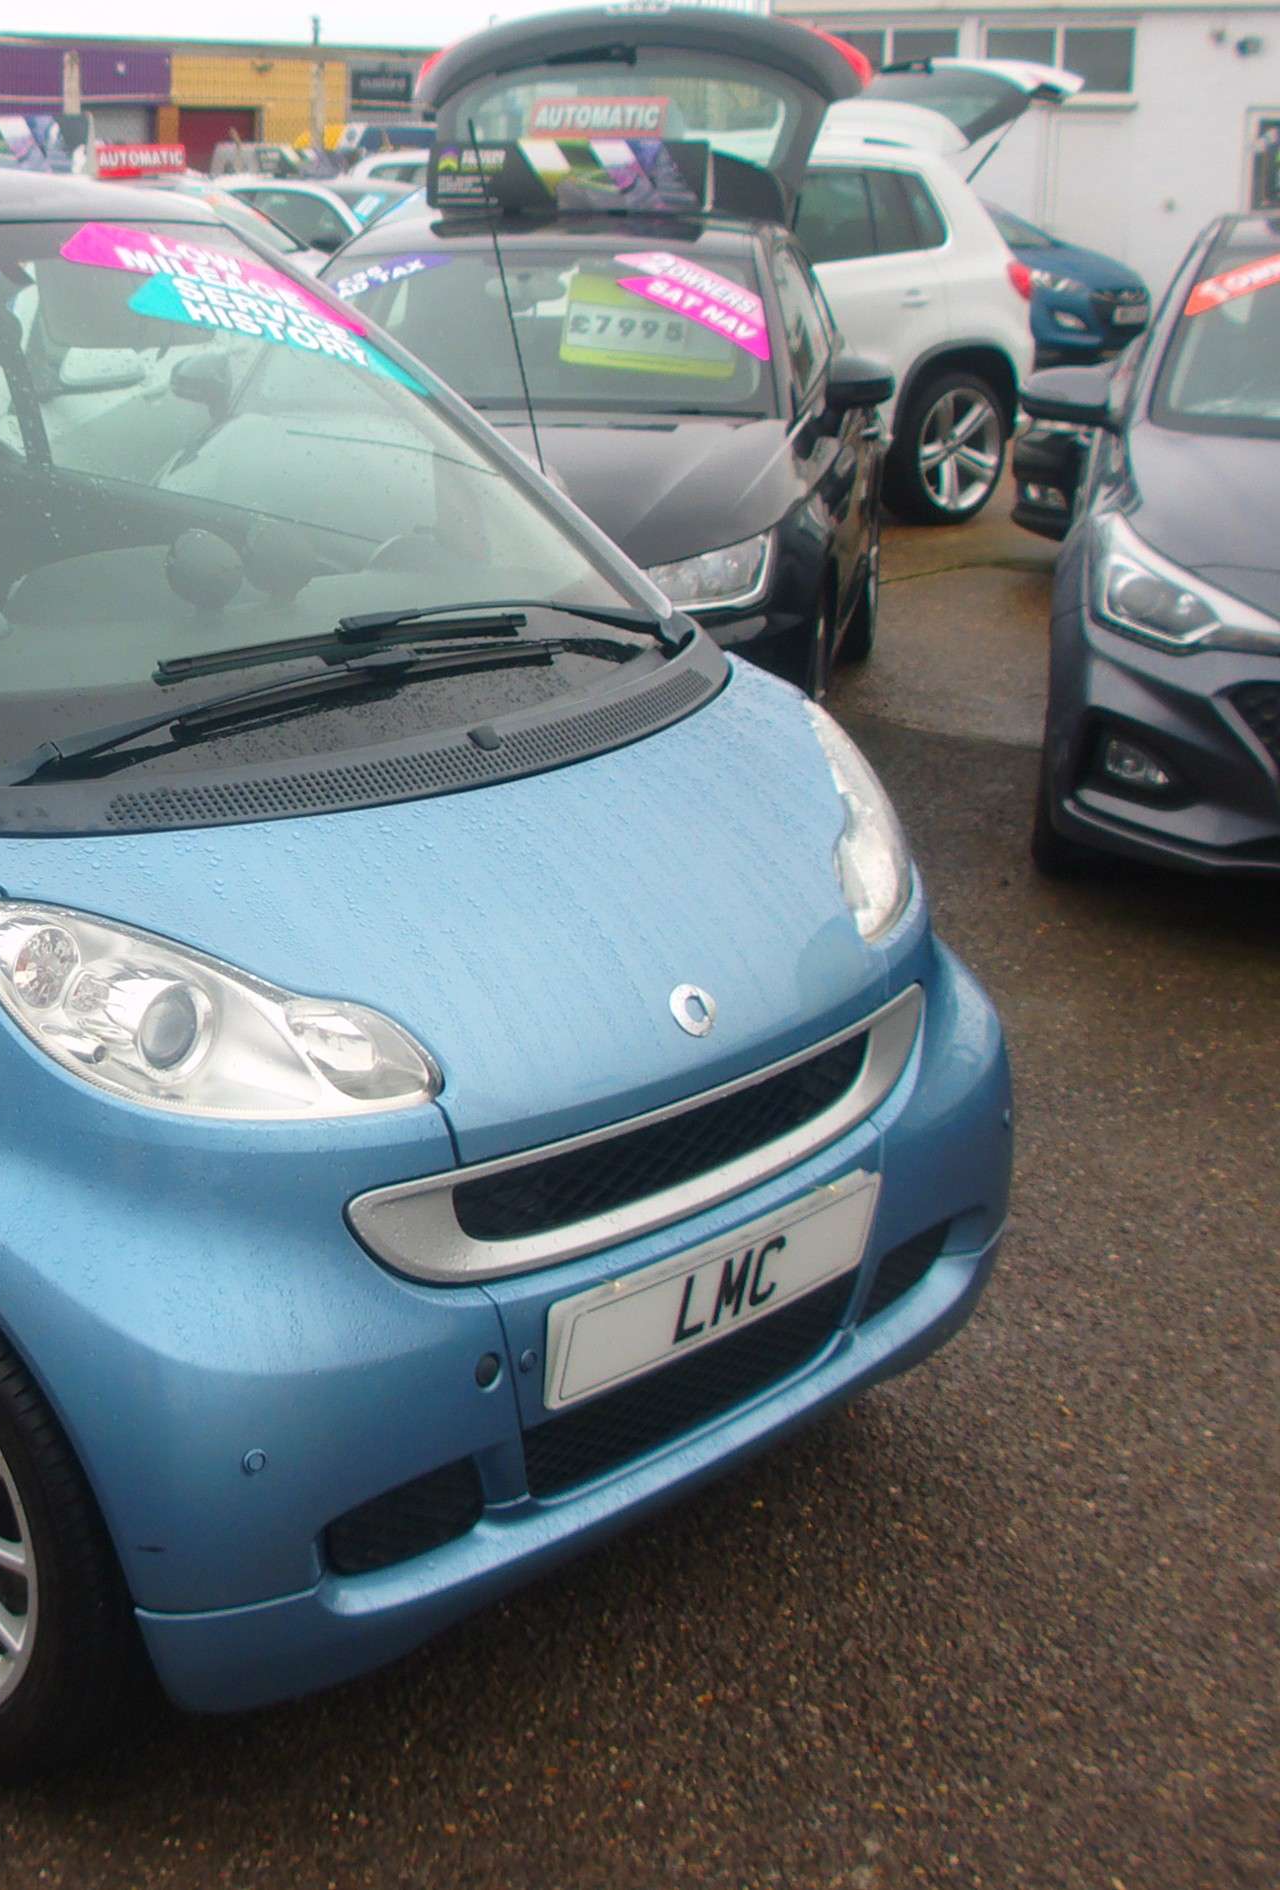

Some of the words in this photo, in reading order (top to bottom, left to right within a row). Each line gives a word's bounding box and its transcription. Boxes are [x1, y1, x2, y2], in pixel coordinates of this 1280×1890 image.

[534, 105, 660, 130] AUTOMATIC
[98, 148, 184, 168] AUTOMATIC
[114, 247, 311, 311] MILEAGE
[149, 236, 242, 275] LOW
[172, 277, 352, 341] SERVICE
[647, 279, 704, 310] SAT
[700, 305, 759, 340] NAV
[669, 264, 759, 315] OWNERS
[182, 300, 369, 366] HISTORY
[570, 314, 684, 343] £7995
[672, 1235, 787, 1345] LMC
